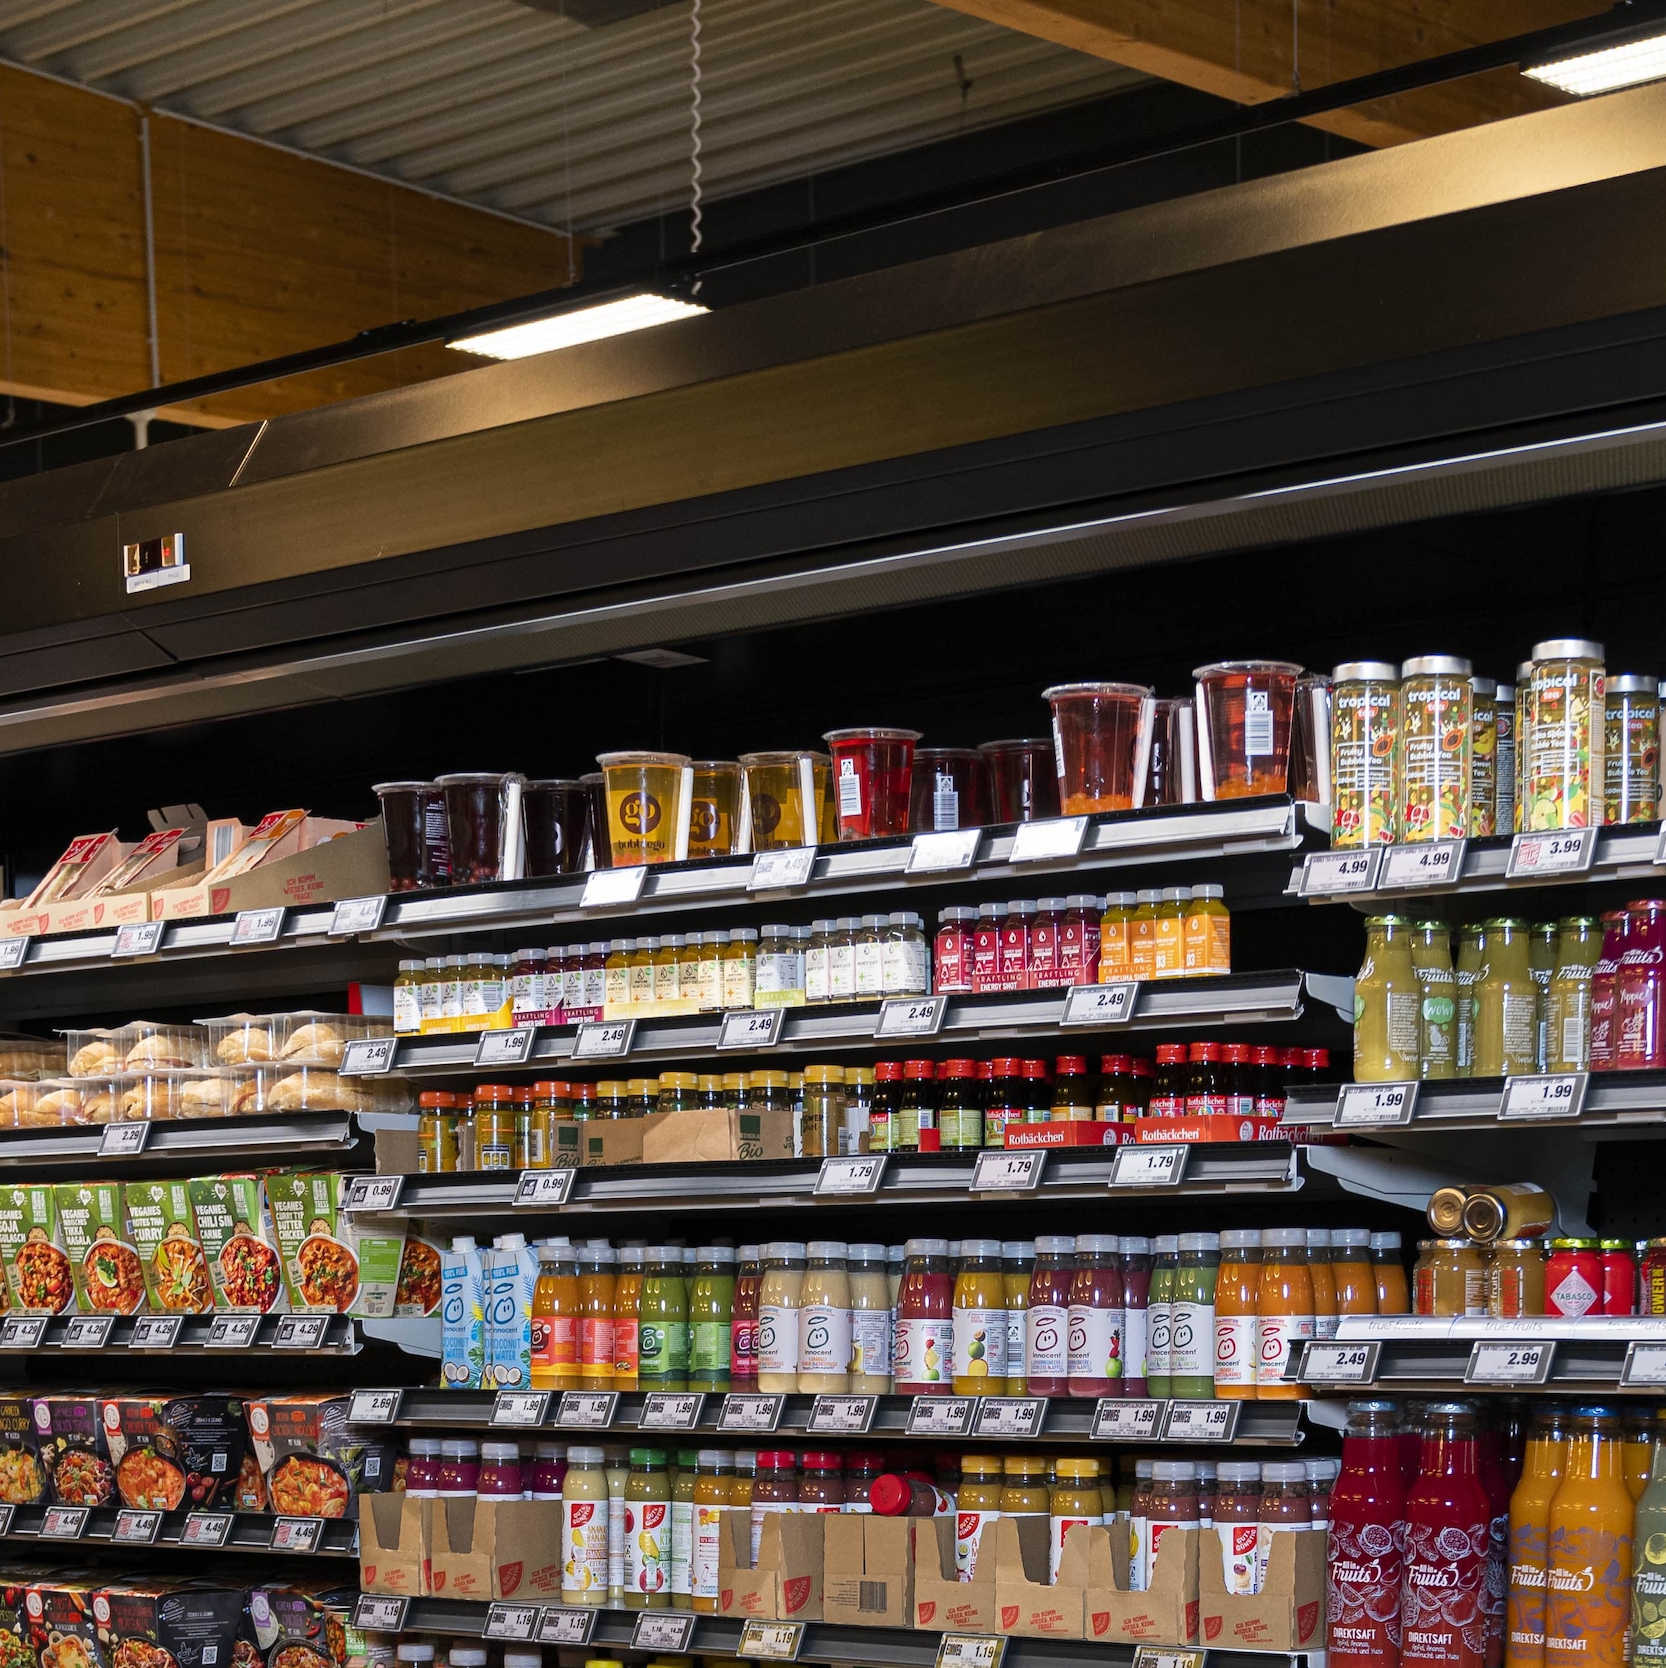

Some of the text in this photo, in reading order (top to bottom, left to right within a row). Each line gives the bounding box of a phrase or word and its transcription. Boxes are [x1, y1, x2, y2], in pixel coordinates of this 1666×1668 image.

[1338, 693, 1391, 710] tropical
[1408, 686, 1461, 703] tropical
[1549, 839, 1582, 856] 3.99
[1337, 858, 1368, 876] 4.99
[1419, 851, 1451, 869] 4.99
[976, 972, 1023, 985] KRAFTLING
[980, 981, 1018, 992] ENERGY SHOT
[1097, 992, 1124, 1007] 2.49
[564, 1006, 604, 1018] KRAFTLING
[602, 1028, 624, 1042] 2.49
[1541, 1085, 1573, 1101] 1.99
[1373, 1093, 1404, 1108] 1.99
[121, 1128, 140, 1142] 2.29
[1009, 1131, 1065, 1145] Rotbäckchen
[1142, 1128, 1200, 1142] Rotbäckchen
[736, 1143, 764, 1159] Bio
[1147, 1154, 1174, 1169] 1.79
[849, 1165, 873, 1178] 1.79
[542, 1177, 564, 1190] 0.99
[277, 1219, 303, 1231] BUTTER
[278, 1228, 307, 1241] CHICKEN
[1556, 1291, 1593, 1302] TABASCO
[299, 1323, 320, 1336] 4.29
[1336, 1352, 1366, 1366] 2.49
[1507, 1351, 1539, 1366] 2.99
[371, 1397, 391, 1410] 2.69
[1408, 1567, 1449, 1587] Fruits
[1332, 1627, 1376, 1641] DIREKTSAFT
[1408, 1631, 1453, 1646] DIREKTSAFT
